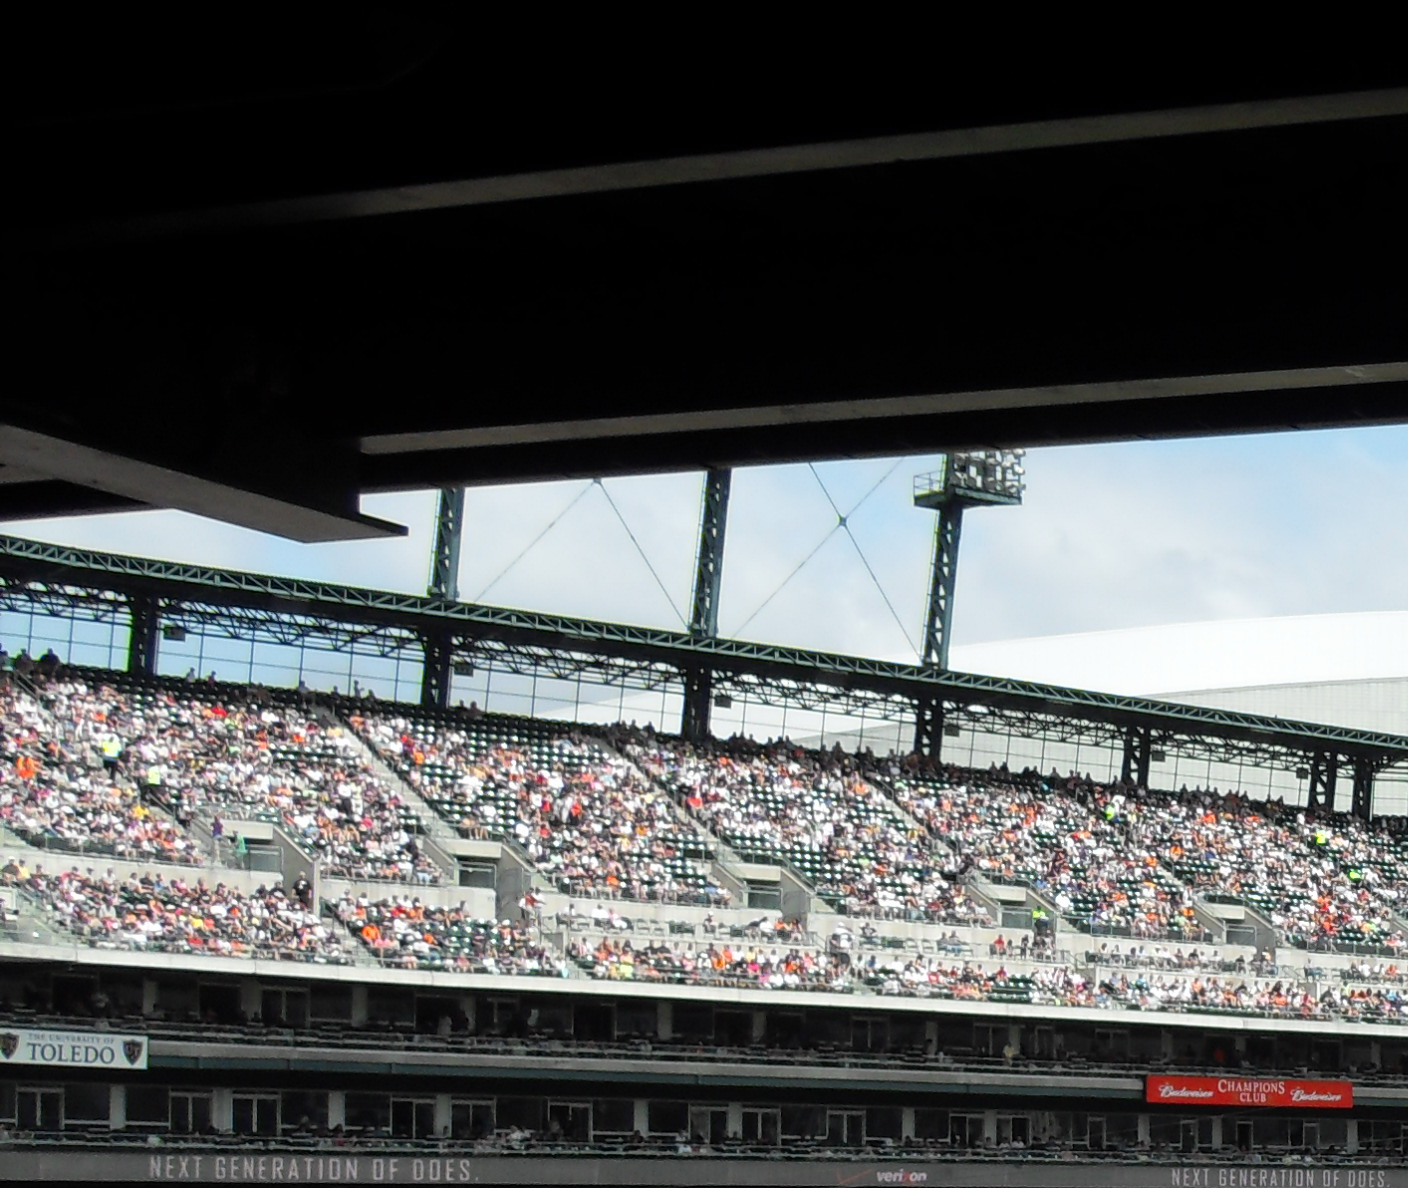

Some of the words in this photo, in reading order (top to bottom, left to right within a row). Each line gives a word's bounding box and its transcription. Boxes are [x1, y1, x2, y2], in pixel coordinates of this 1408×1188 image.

[27, 1042, 115, 1065] TOLEDO
[1159, 1083, 1213, 1098] Budweiser
[1217, 1079, 1285, 1094] CHAMPIONS
[1290, 1088, 1342, 1101] Budweiser
[1239, 1092, 1267, 1103] CLUB
[150, 1155, 203, 1179] NEXT
[215, 1156, 358, 1181] GENERATION
[372, 1158, 399, 1181] OF
[876, 1169, 927, 1183] verizon
[1171, 1168, 1210, 1186] NEXT
[1218, 1168, 1314, 1188] GENERATION
[1323, 1170, 1341, 1188] OF
